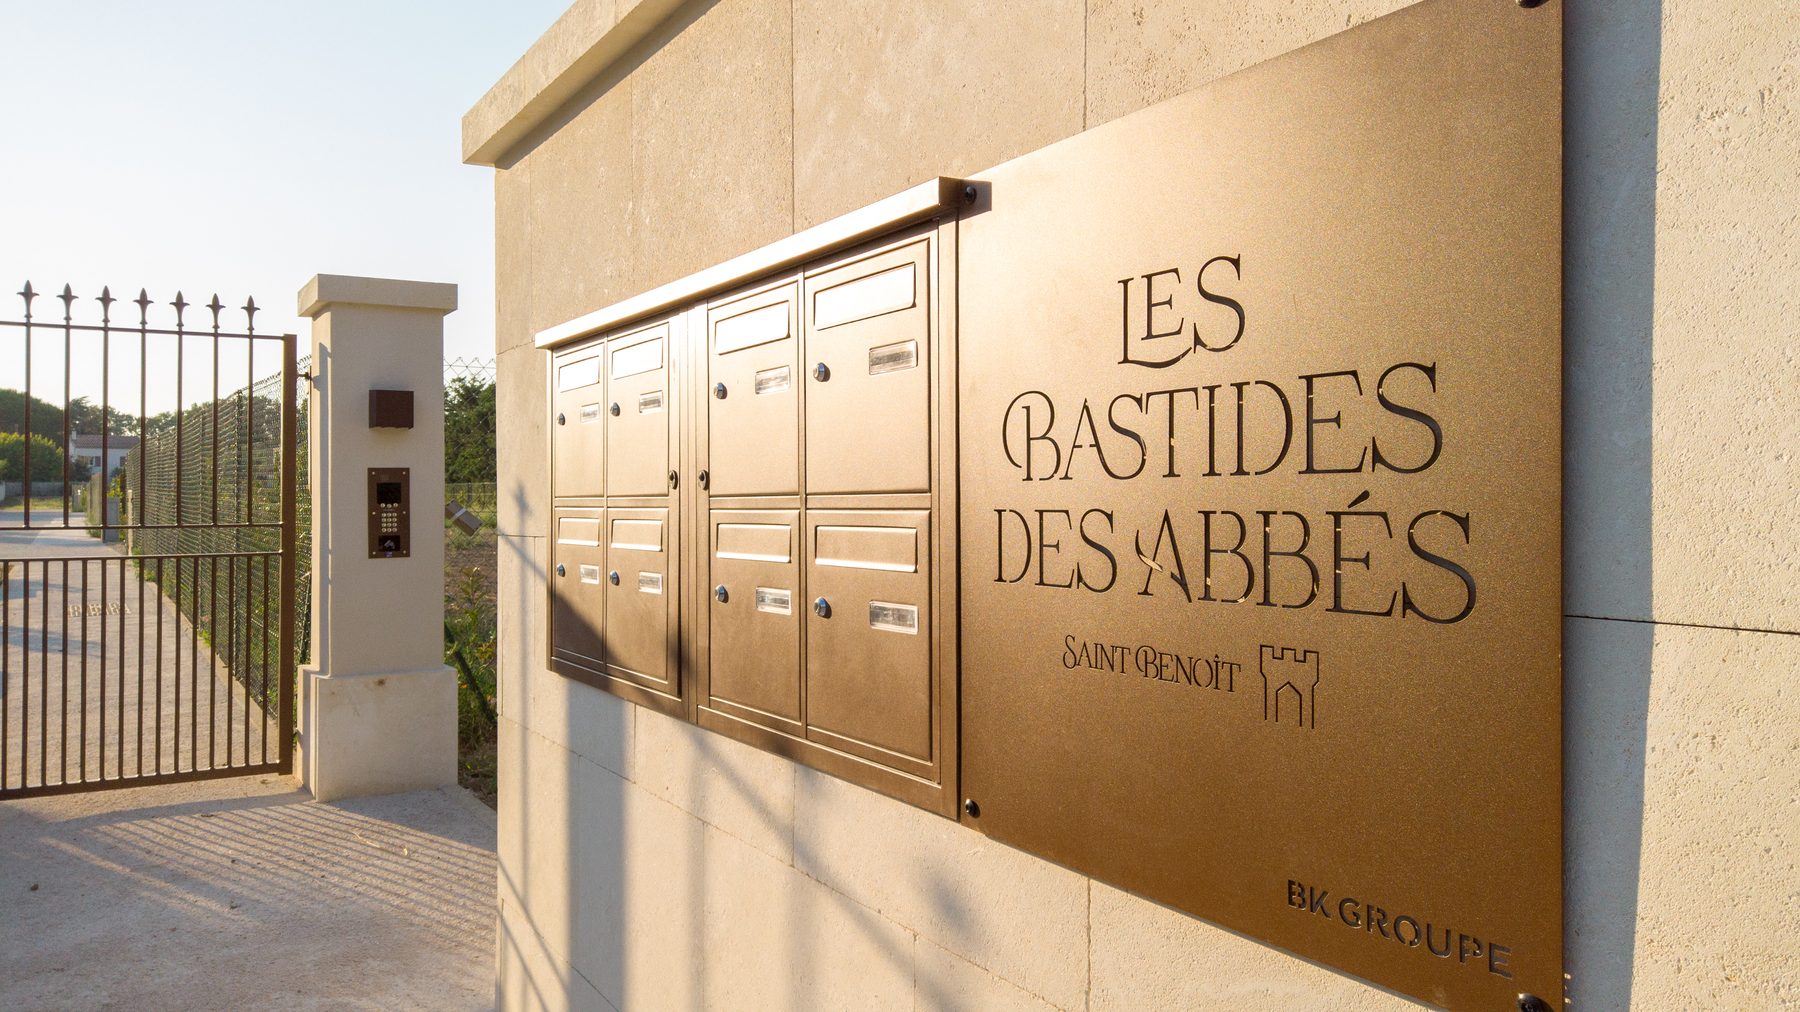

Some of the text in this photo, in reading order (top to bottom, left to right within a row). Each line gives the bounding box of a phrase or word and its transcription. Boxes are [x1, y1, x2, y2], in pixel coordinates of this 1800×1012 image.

[1118, 253, 1246, 369] LES
[1002, 361, 1443, 481] BASTIDES
[993, 490, 1478, 625] DES ABBÉS
[1062, 634, 1242, 692] SAINT BENOÎT
[1287, 879, 1513, 980] BK GROUPE
